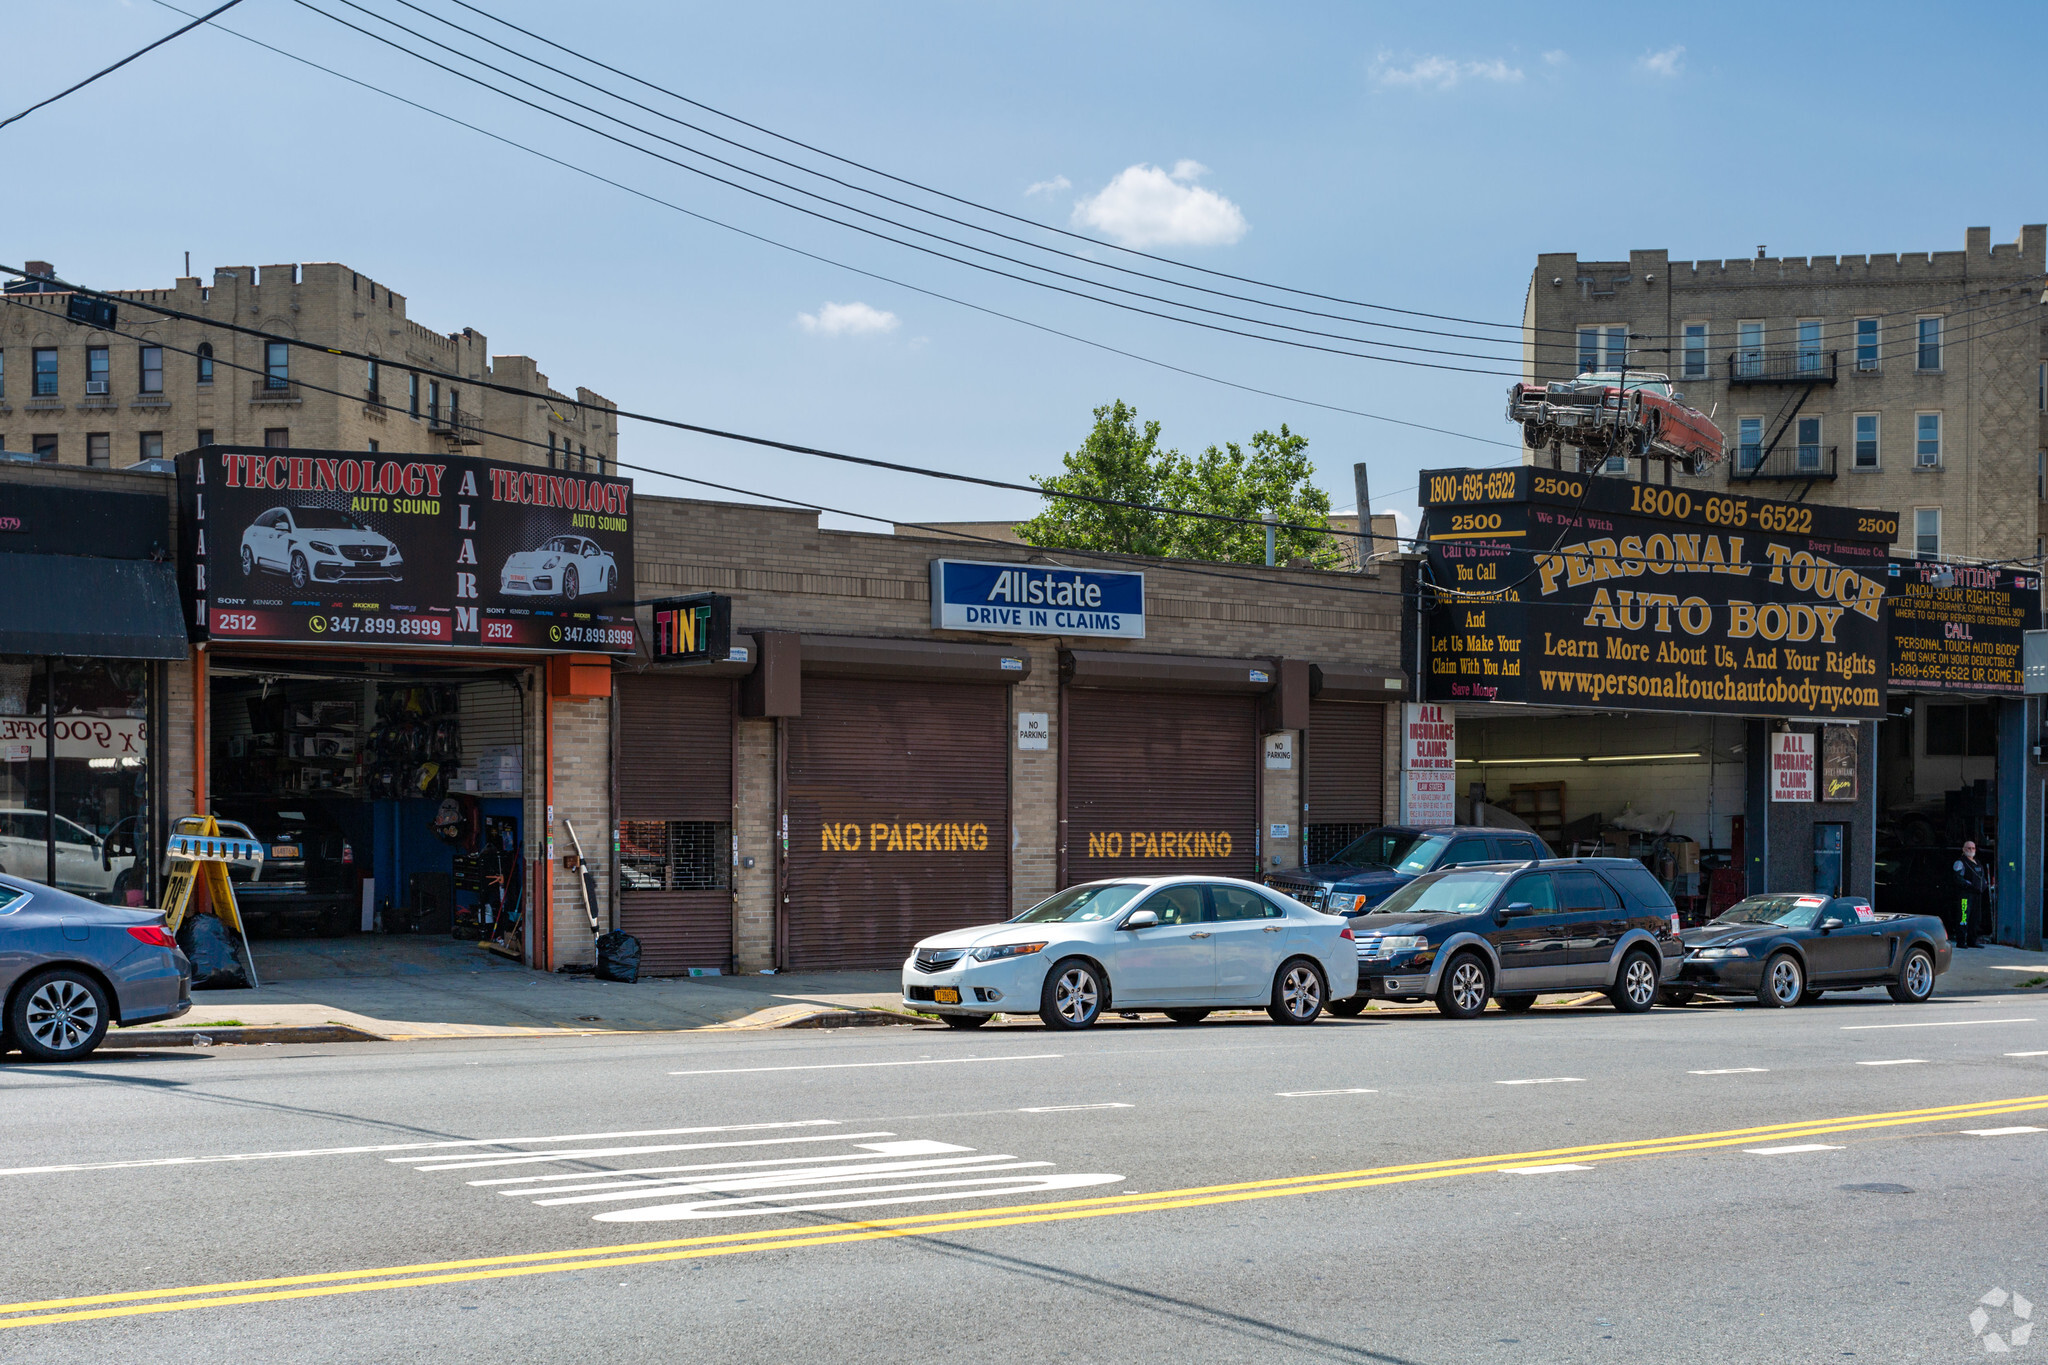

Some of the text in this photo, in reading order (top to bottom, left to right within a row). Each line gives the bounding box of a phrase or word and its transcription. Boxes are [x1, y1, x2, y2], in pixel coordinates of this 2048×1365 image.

[222, 454, 447, 497] TECHNOLOGY
[489, 468, 630, 515] TECHNOLOGY
[1430, 472, 1515, 502] 1800-695-6522
[1534, 477, 1583, 498] 2500
[351, 497, 441, 515] AUTO SOUND
[1630, 486, 1812, 534] 1800-695-6522
[572, 513, 627, 533] AUTO SOUND
[1452, 514, 1501, 530] 2500
[1536, 512, 1614, 531] We Deal With
[1858, 518, 1897, 534] 2500
[196, 457, 206, 627] ALARM
[1442, 541, 1462, 558] Call
[1465, 541, 1476, 558] Us
[1808, 540, 1885, 557] Every Insurance Co.
[455, 470, 479, 633] ALARM
[1456, 563, 1496, 580] You Call
[1533, 533, 1886, 622] PERSONAL TOUCH
[987, 570, 1101, 607] Allstate
[1906, 583, 2010, 606] KNOW YOUR RIGHTS!!!
[1583, 587, 1844, 643] AUTO BODY
[1895, 608, 1916, 619] WHERE
[1917, 610, 1925, 619] TO
[1927, 611, 1935, 620] GO
[1950, 613, 1976, 623] REPAIRS
[1977, 616, 1985, 625] OR
[1901, 599, 1912, 607] LET
[1932, 601, 1967, 614] INSURANCE
[1968, 604, 1996, 615] COMPANY
[1997, 606, 2011, 616] TELL
[2012, 608, 2025, 617] YOU
[219, 614, 441, 636] 2512 347.899.8999
[966, 606, 1121, 631] DRIVE IN CLAIMS
[1465, 610, 1485, 627] And
[487, 623, 633, 645] 2512 347.899.8999
[656, 605, 711, 655] TINT
[1945, 622, 1973, 640] CALL
[1432, 634, 1521, 652] Let Us Make Your
[1944, 640, 1970, 653] TOUCH
[1972, 642, 1993, 654] AUTO
[1544, 632, 1876, 680] Learn More About Us, And Your Rights
[1901, 651, 1916, 662] AND
[1918, 652, 1937, 663] SAVE
[1939, 653, 1949, 664] ON
[1951, 654, 1969, 665] YOUR
[1432, 657, 1520, 675] Claim With You And
[1891, 663, 1970, 680] 1-800-695-6522
[1972, 668, 1985, 682] OR
[1988, 669, 2012, 683] COME
[1452, 682, 1498, 701] Save Money
[1540, 670, 1879, 712] www.personaltouchautobodyny.com
[1420, 706, 1444, 722] ALL
[1029, 721, 1038, 729] NO
[1410, 723, 1454, 740] INSURANCE
[1020, 731, 1047, 739] PARKING
[1783, 736, 1804, 752] ALL
[1267, 751, 1290, 759] PARKING
[1275, 742, 1283, 750] NO
[1417, 741, 1447, 757] CLAIMS
[1411, 758, 1453, 768] MADE HERE
[1774, 753, 1813, 771] INSURANCE
[1780, 771, 1807, 788] CLAIMS
[1828, 779, 1851, 796] Open
[1775, 790, 1812, 799] MADE HERE
[821, 822, 989, 852] NO PARKING
[1088, 831, 1232, 858] NO PARKING
